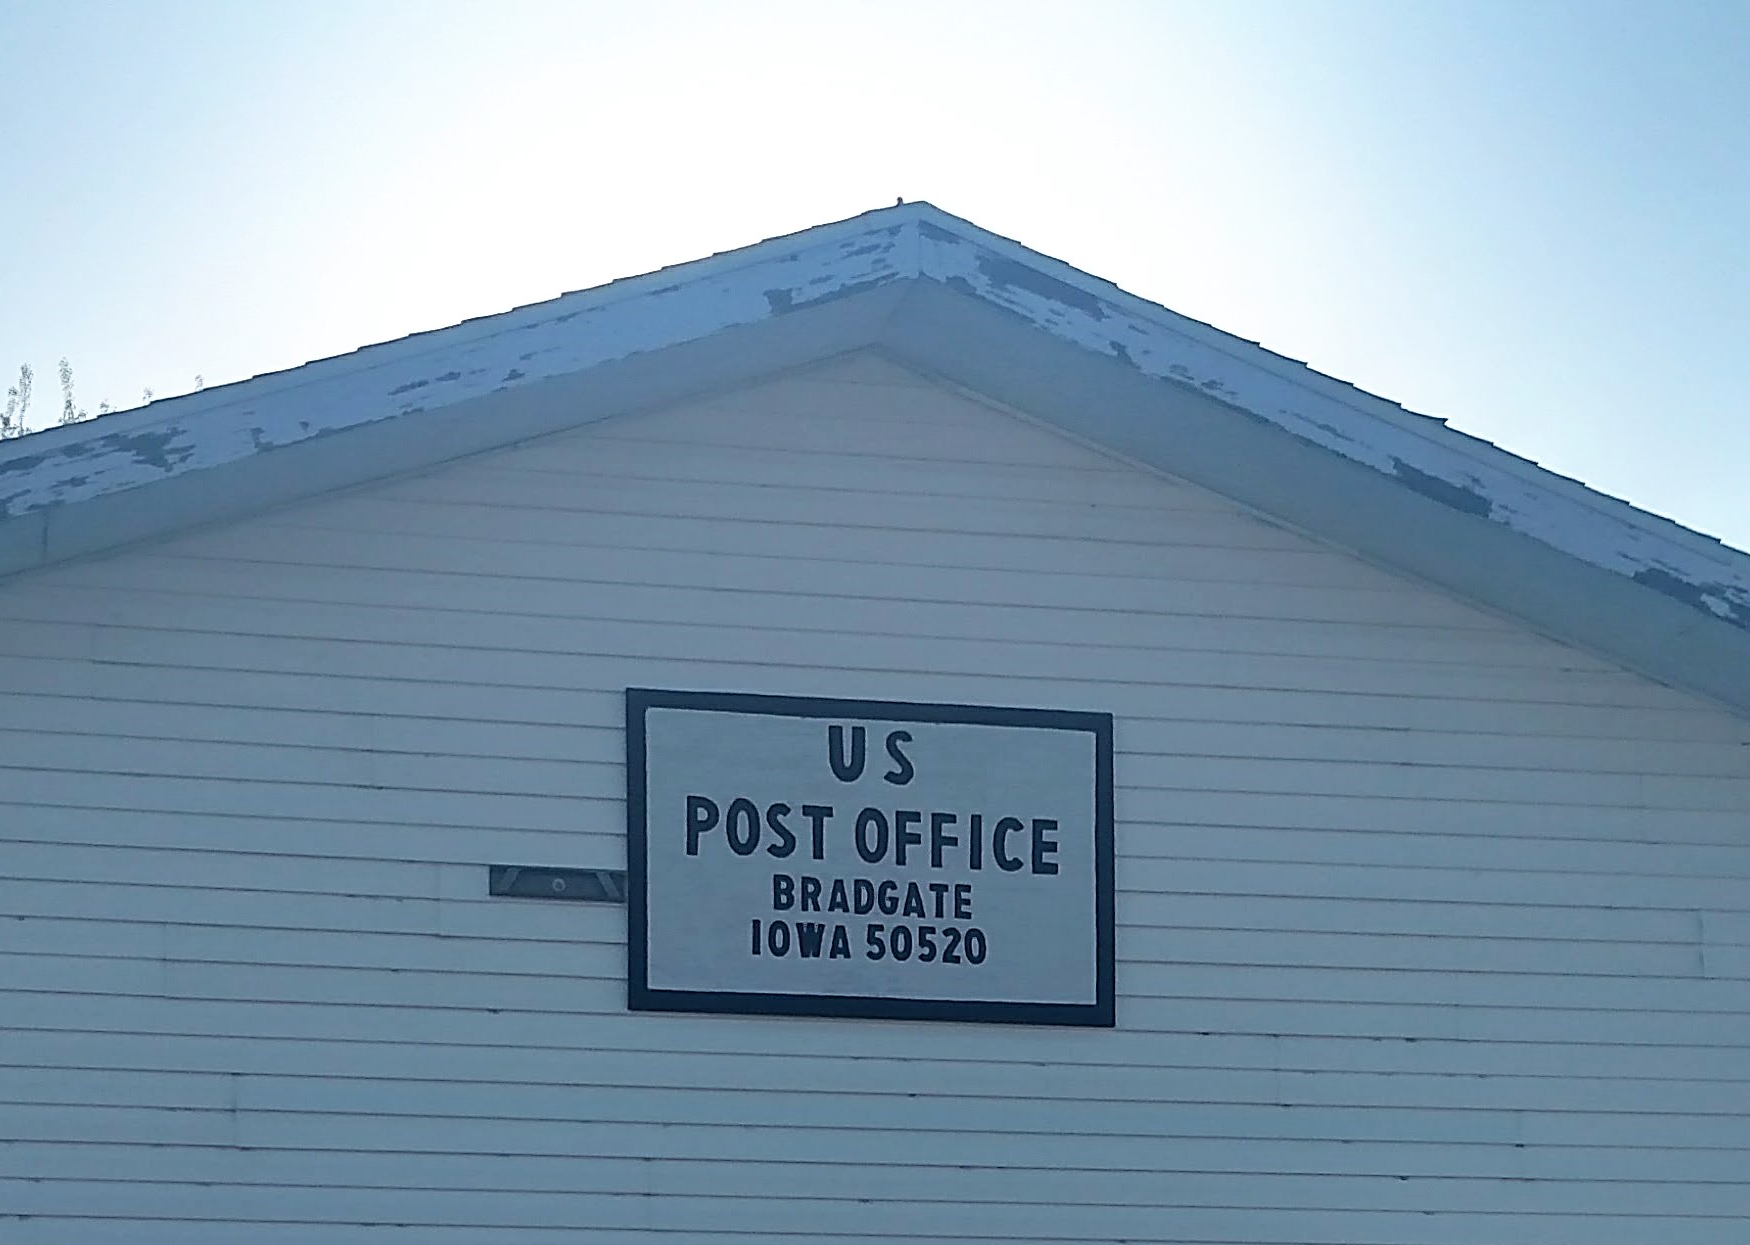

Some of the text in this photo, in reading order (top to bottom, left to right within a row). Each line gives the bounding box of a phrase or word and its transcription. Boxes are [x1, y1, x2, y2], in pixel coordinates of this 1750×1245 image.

[686, 795, 1060, 875] POST OFFICE
[773, 874, 972, 920] BRADGATE
[752, 919, 987, 965] IOWA 50520
